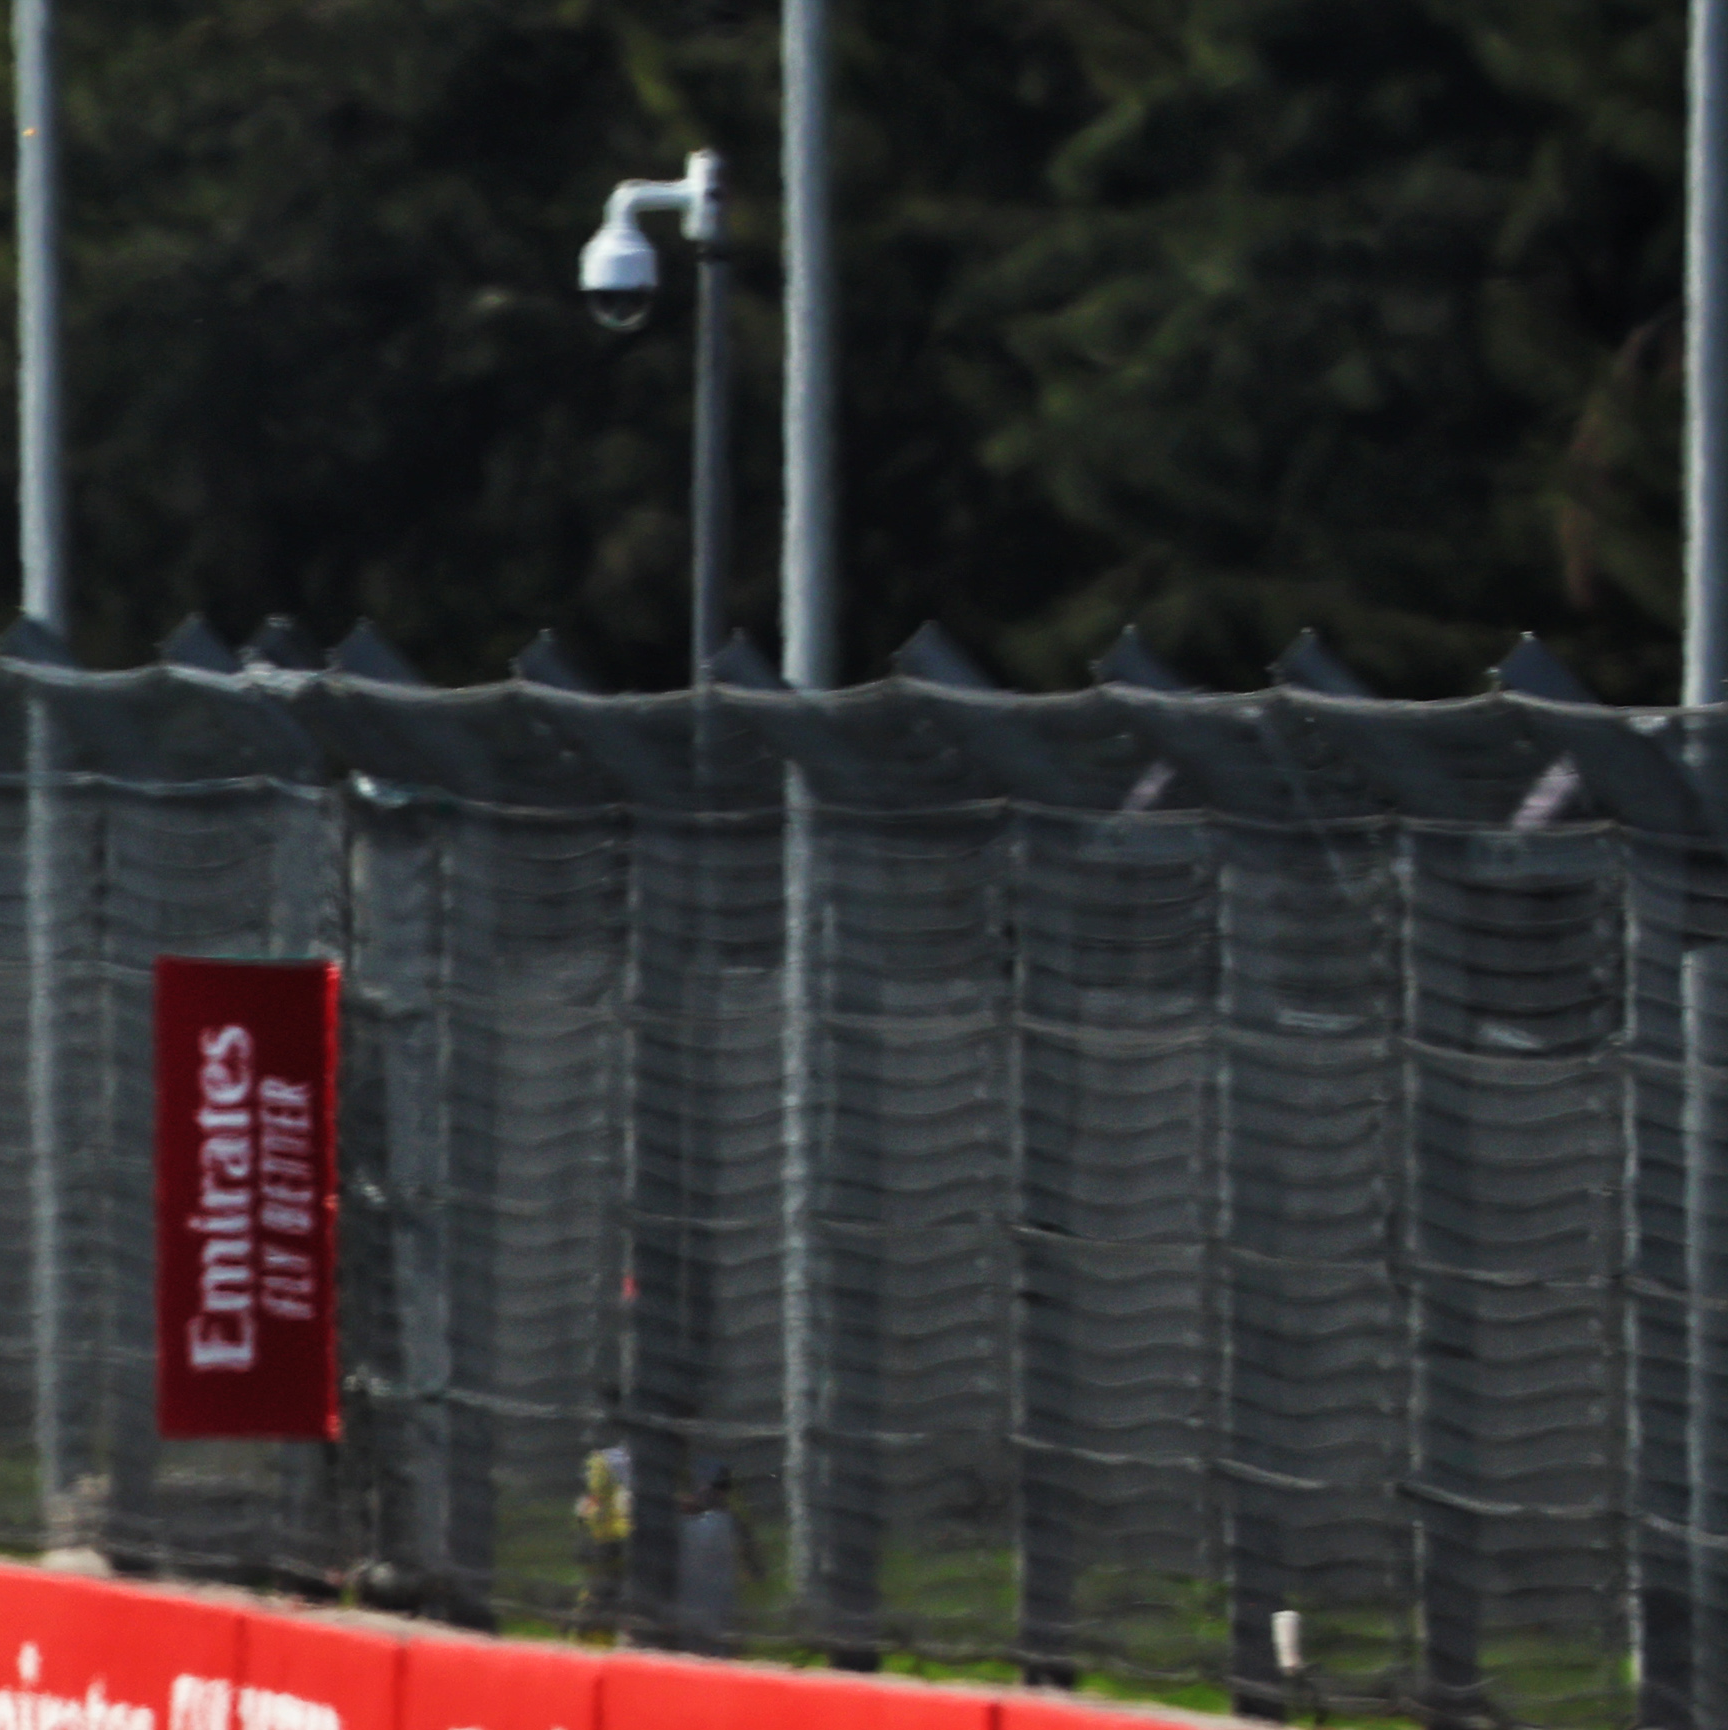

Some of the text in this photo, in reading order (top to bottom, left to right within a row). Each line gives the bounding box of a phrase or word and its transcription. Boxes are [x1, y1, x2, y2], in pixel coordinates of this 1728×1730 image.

[187, 1022, 256, 1372] Emirates
[257, 1075, 316, 1322] FLY BETTER
